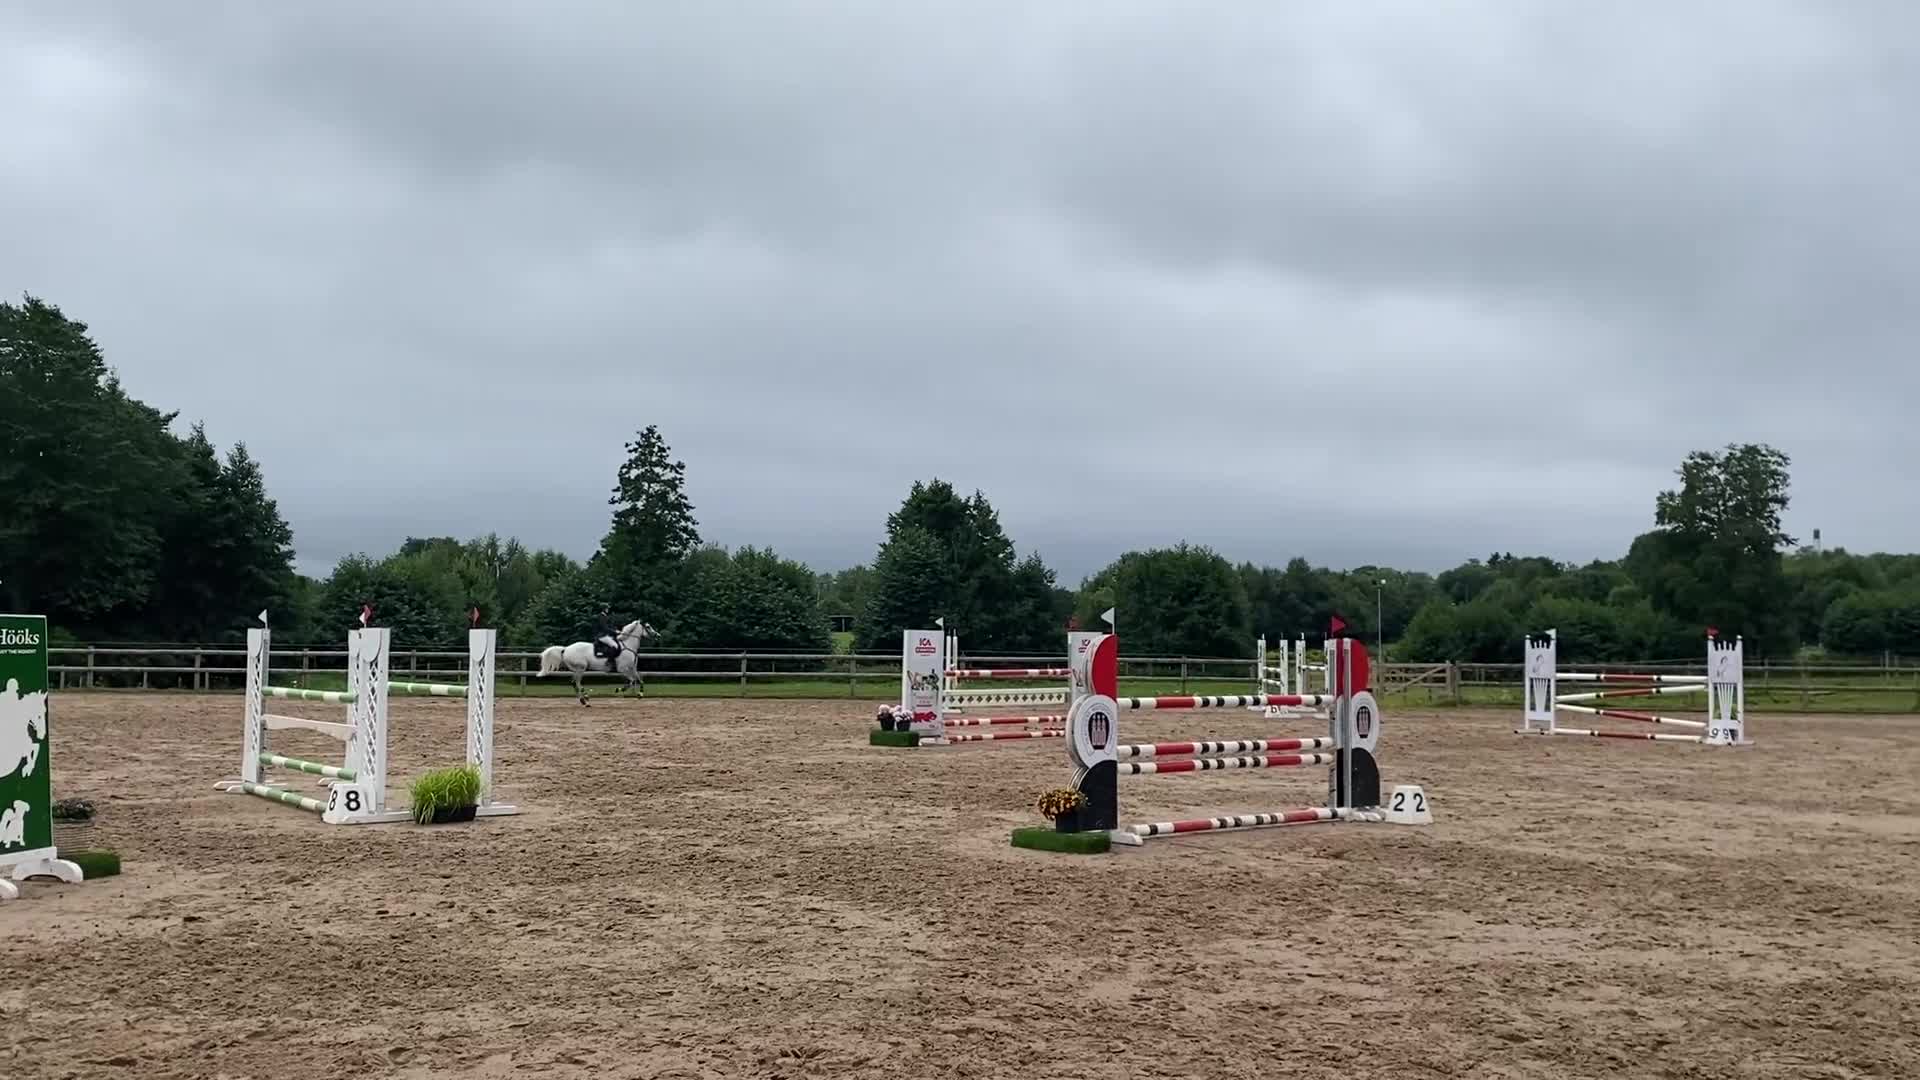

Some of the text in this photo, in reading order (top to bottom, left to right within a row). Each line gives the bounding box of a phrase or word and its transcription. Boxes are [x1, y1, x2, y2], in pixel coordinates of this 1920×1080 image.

[919, 637, 932, 646] ICA
[329, 790, 338, 811] 8
[345, 790, 361, 812] 8
[1393, 792, 1405, 812] 2
[1413, 792, 1426, 812] 2
